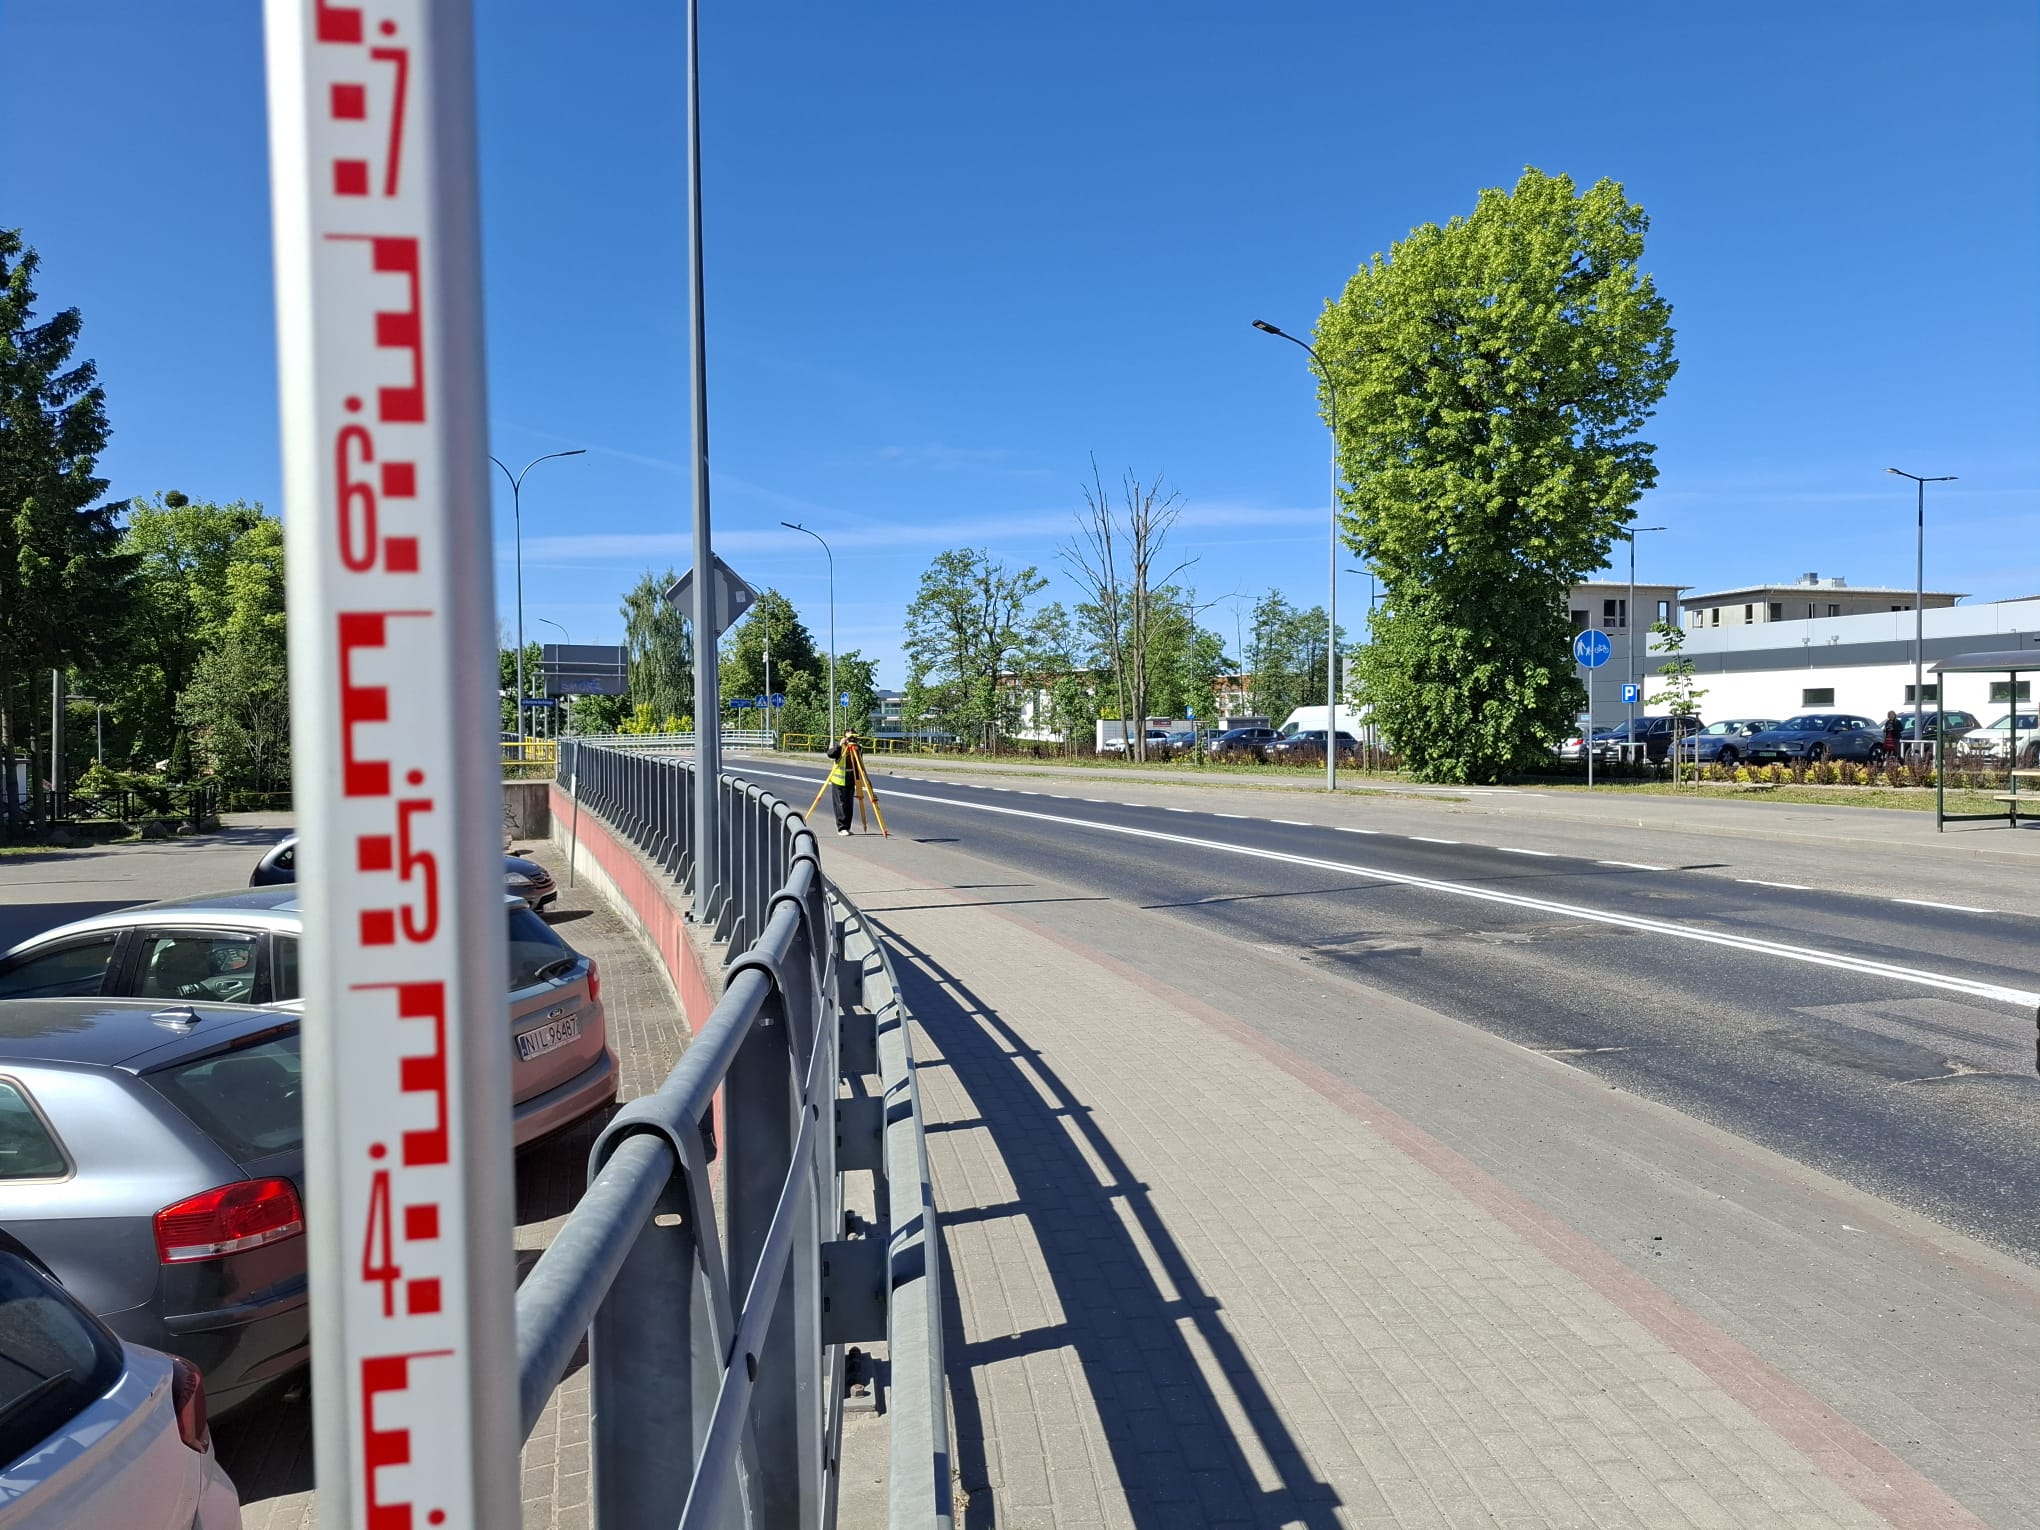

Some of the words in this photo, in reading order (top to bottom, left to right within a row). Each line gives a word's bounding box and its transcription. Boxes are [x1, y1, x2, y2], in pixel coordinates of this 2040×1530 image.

[371, 47, 409, 197] 7
[336, 425, 378, 573] 6
[1625, 686, 1634, 701] P
[397, 799, 440, 944] 5
[525, 1031, 548, 1053] NIL
[548, 1018, 576, 1043] 96487
[362, 1169, 402, 1318] 4
